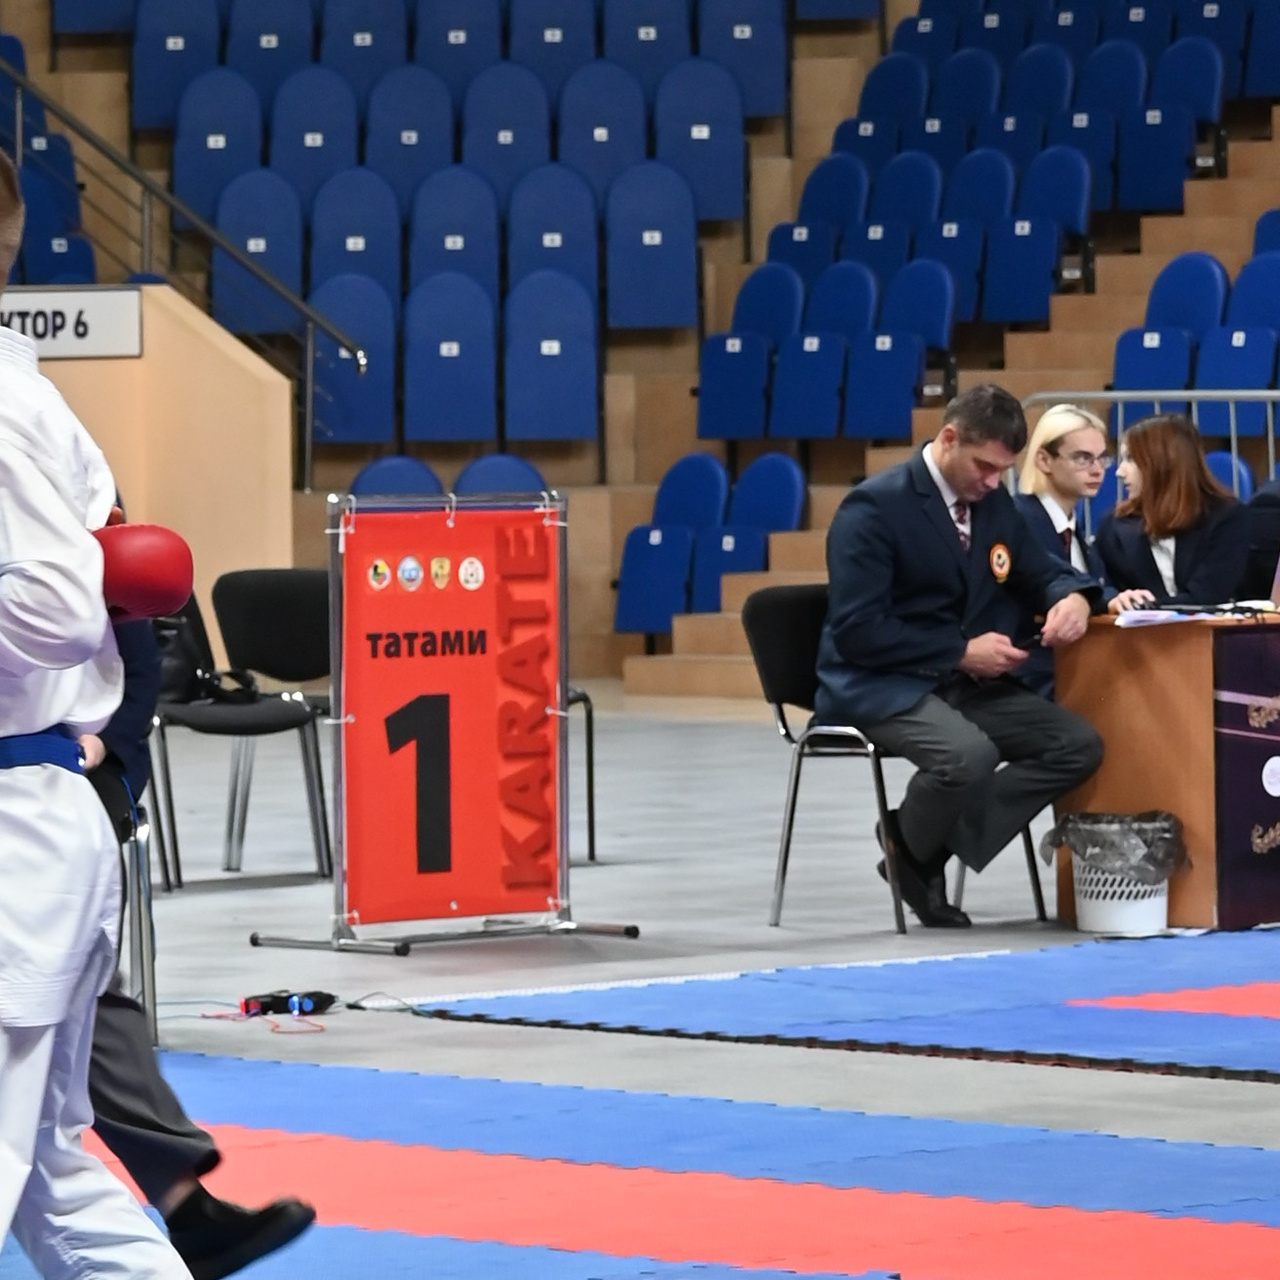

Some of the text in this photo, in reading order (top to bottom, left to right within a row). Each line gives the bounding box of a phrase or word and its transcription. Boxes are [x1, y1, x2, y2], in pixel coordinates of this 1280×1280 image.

[0, 310, 88, 340] КТОР 6
[365, 629, 488, 660] татами
[495, 525, 553, 893] KARATE
[384, 693, 452, 874] 1
